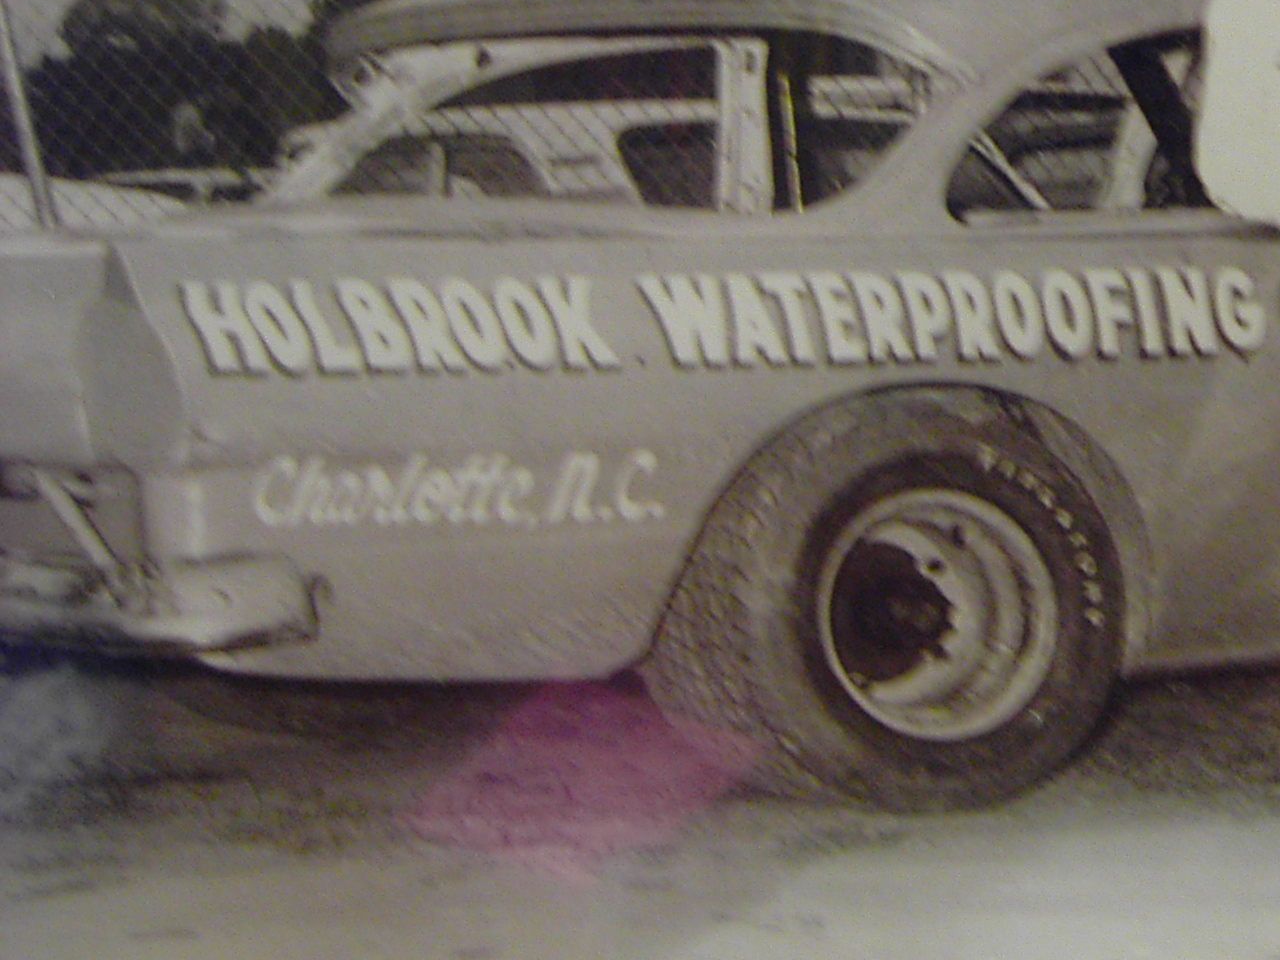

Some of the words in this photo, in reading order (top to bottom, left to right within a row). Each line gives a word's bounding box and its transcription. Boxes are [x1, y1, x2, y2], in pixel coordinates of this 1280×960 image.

[180, 277, 619, 375] HOLBROOK
[637, 267, 1268, 366] WATERPROOFING
[548, 448, 666, 524] N.C.
